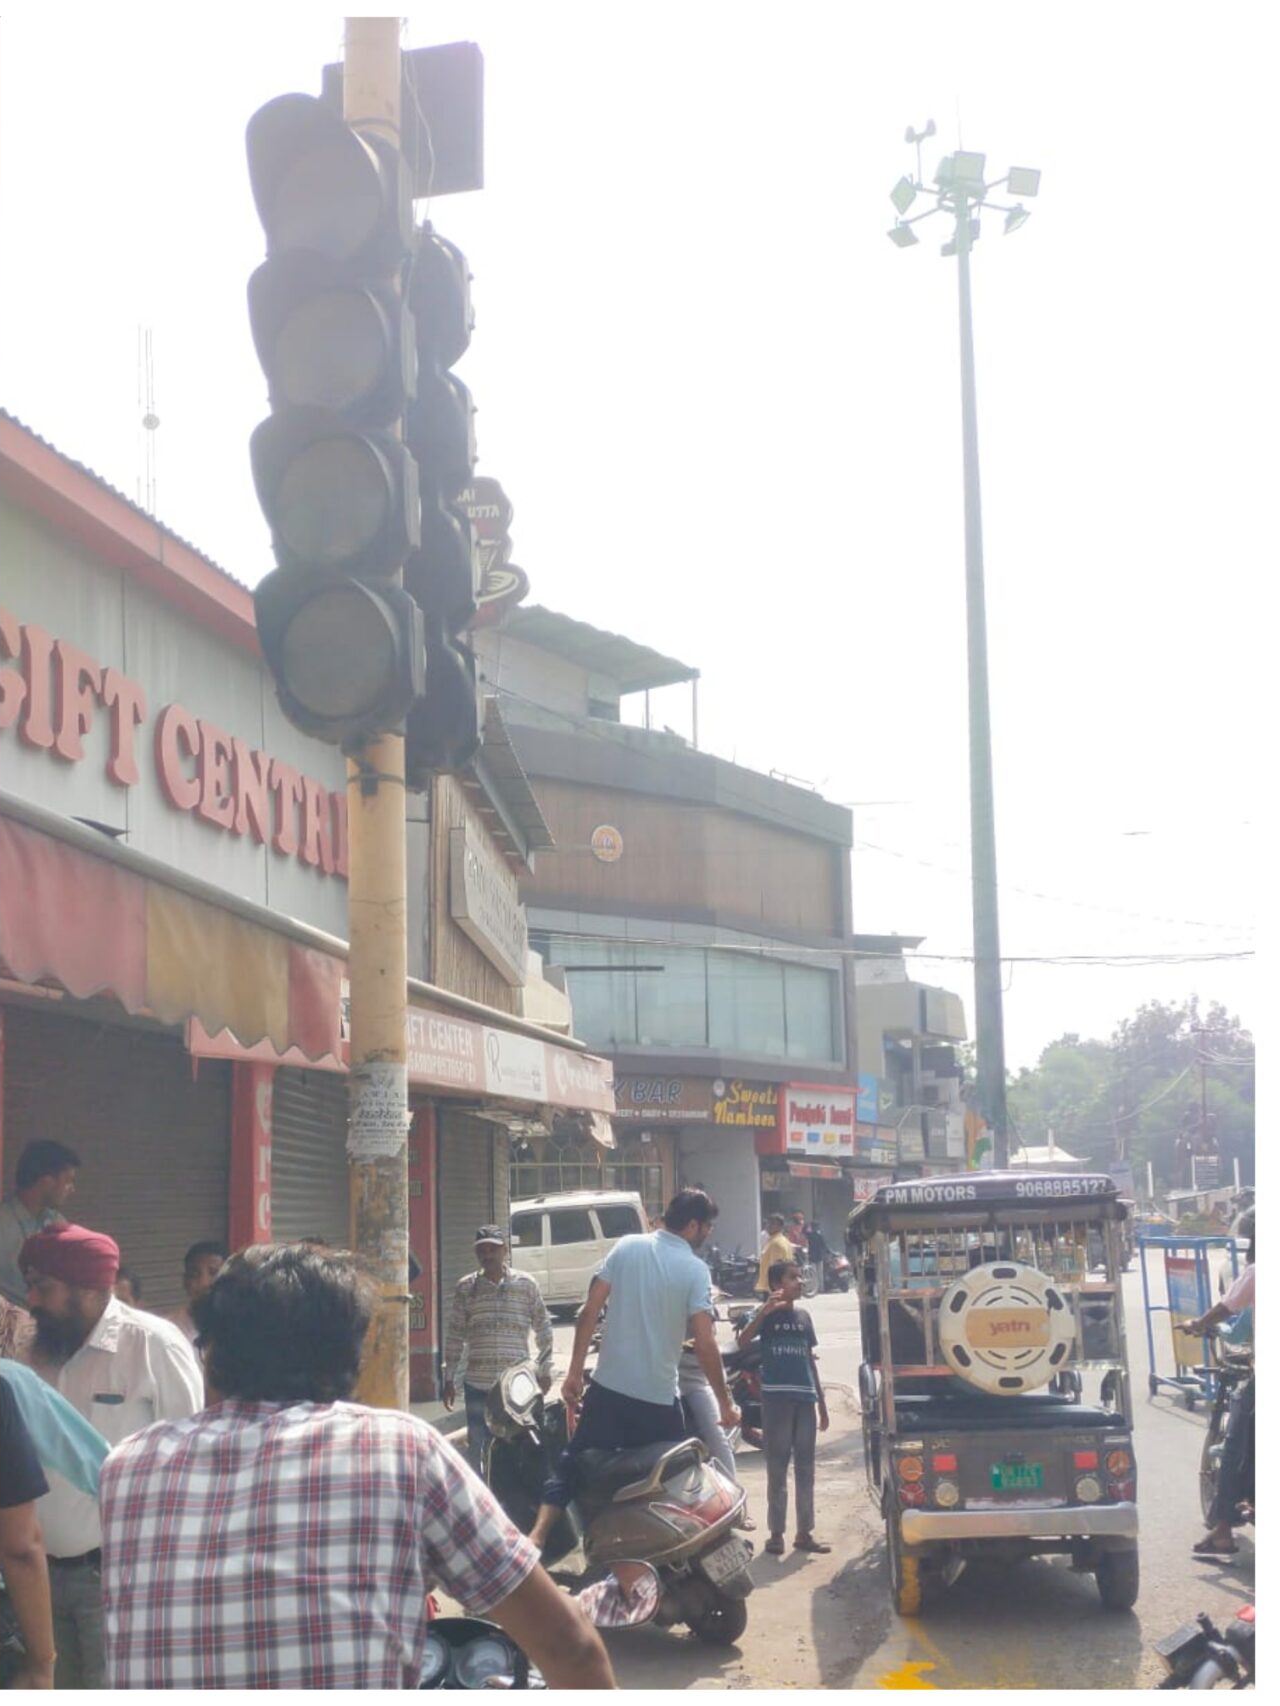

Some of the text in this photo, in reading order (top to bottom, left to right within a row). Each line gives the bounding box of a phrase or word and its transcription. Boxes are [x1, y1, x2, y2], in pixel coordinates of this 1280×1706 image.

[428, 1017, 474, 1058] CENTER
[631, 1079, 683, 1104] BAR
[724, 1080, 778, 1105] Sweets
[713, 1100, 776, 1127] Namkeen
[885, 1188, 908, 1204] PM
[910, 1184, 977, 1203] MOTORS
